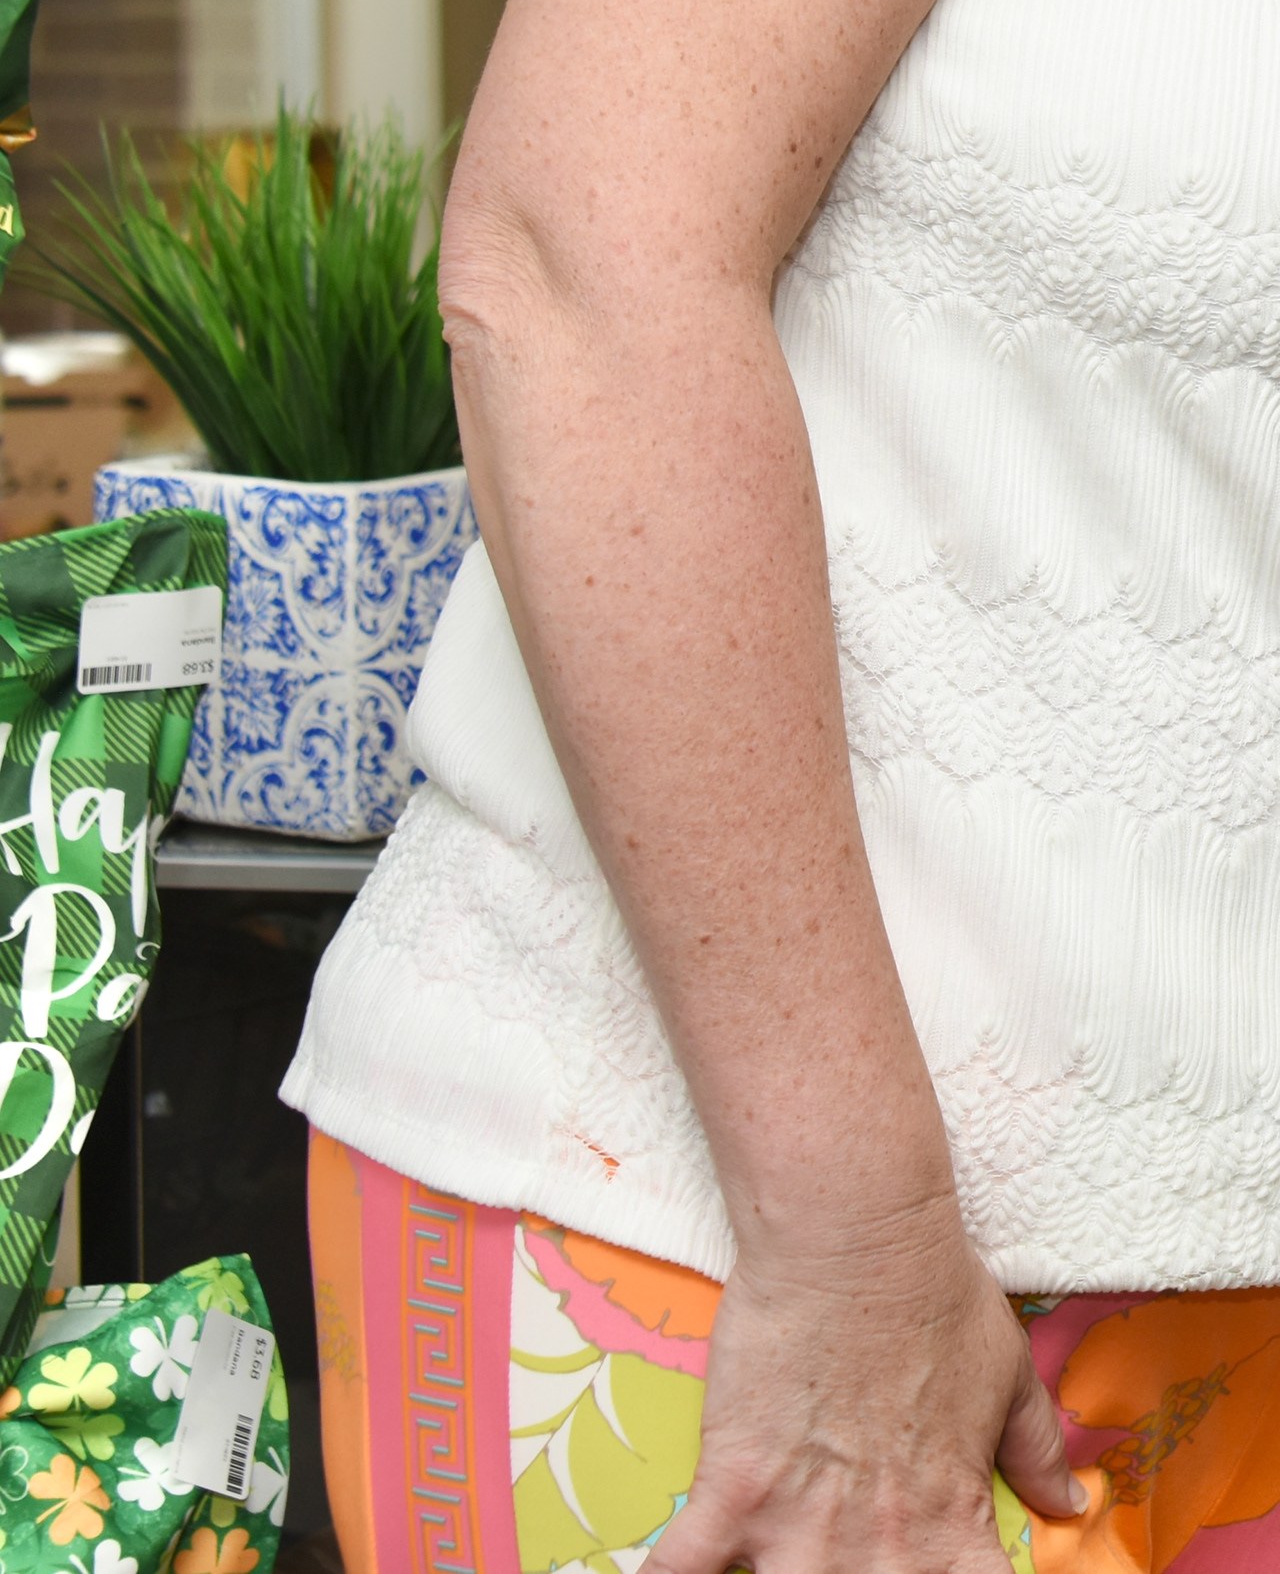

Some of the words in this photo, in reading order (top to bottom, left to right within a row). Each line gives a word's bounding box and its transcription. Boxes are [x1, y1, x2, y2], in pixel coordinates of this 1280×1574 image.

[181, 636, 215, 647] Bandana
[182, 658, 214, 676] $3.68
[230, 1329, 245, 1376] Bandana
[250, 1336, 267, 1380] $3.68
